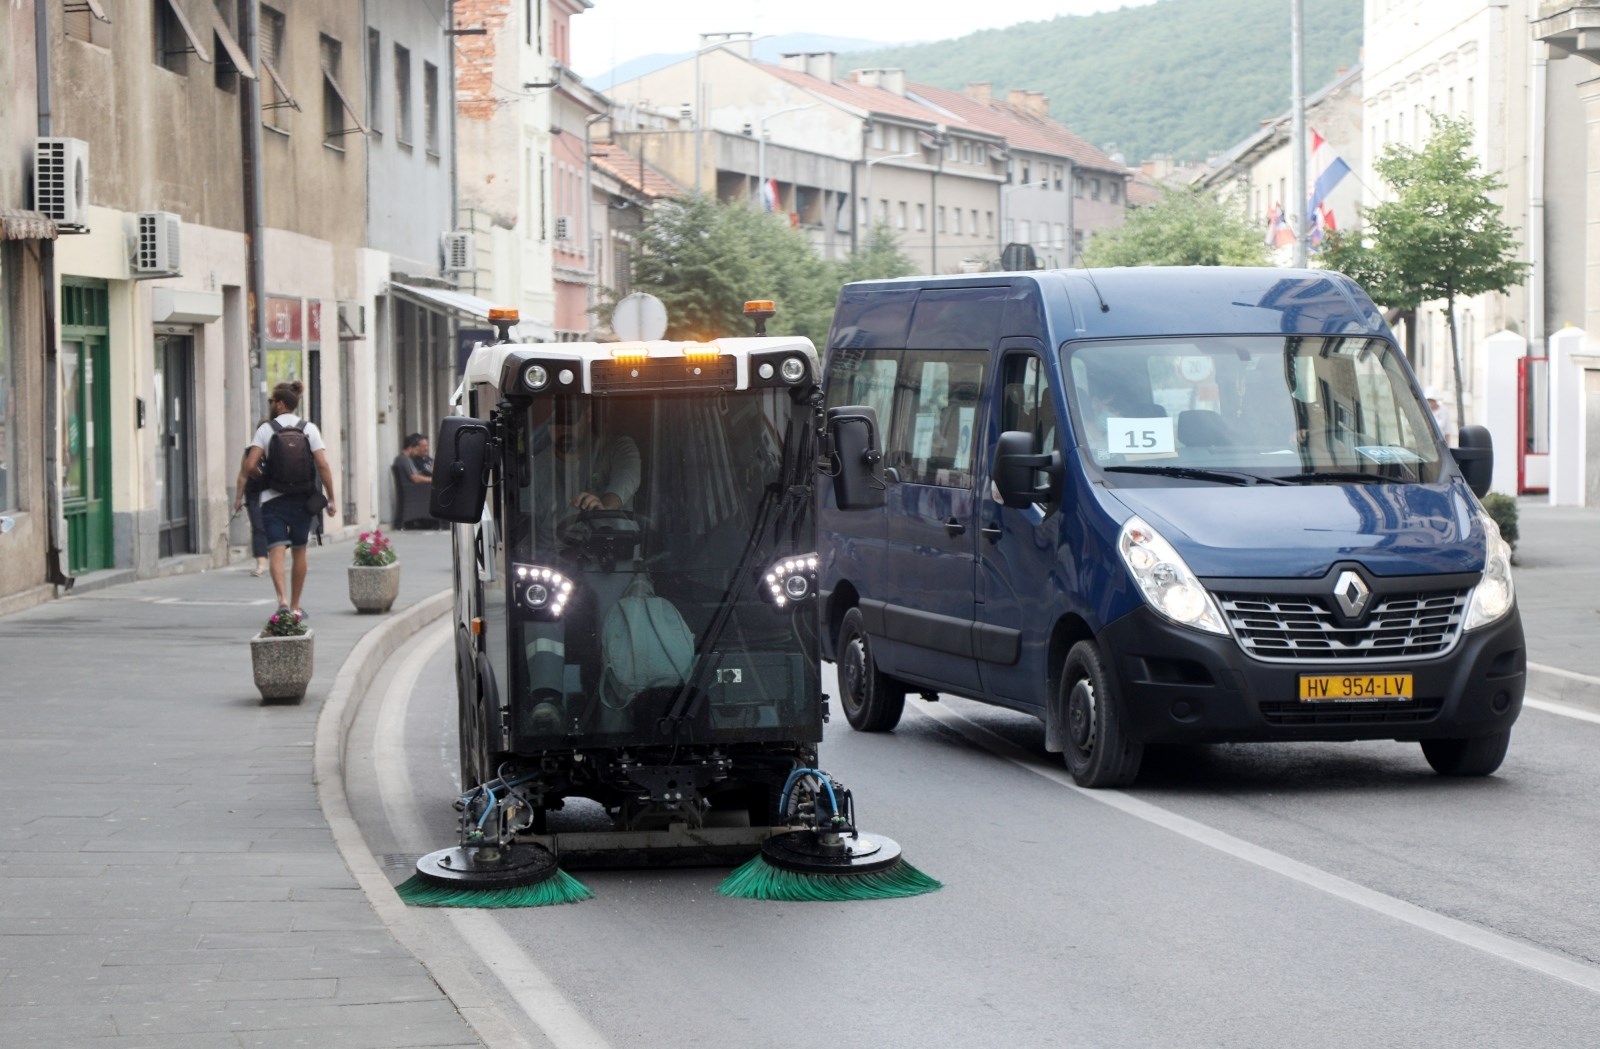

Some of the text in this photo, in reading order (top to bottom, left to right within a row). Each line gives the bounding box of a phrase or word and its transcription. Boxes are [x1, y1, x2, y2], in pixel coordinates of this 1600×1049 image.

[1124, 430, 1157, 448] 15
[1308, 677, 1405, 697] HV 954-LV
